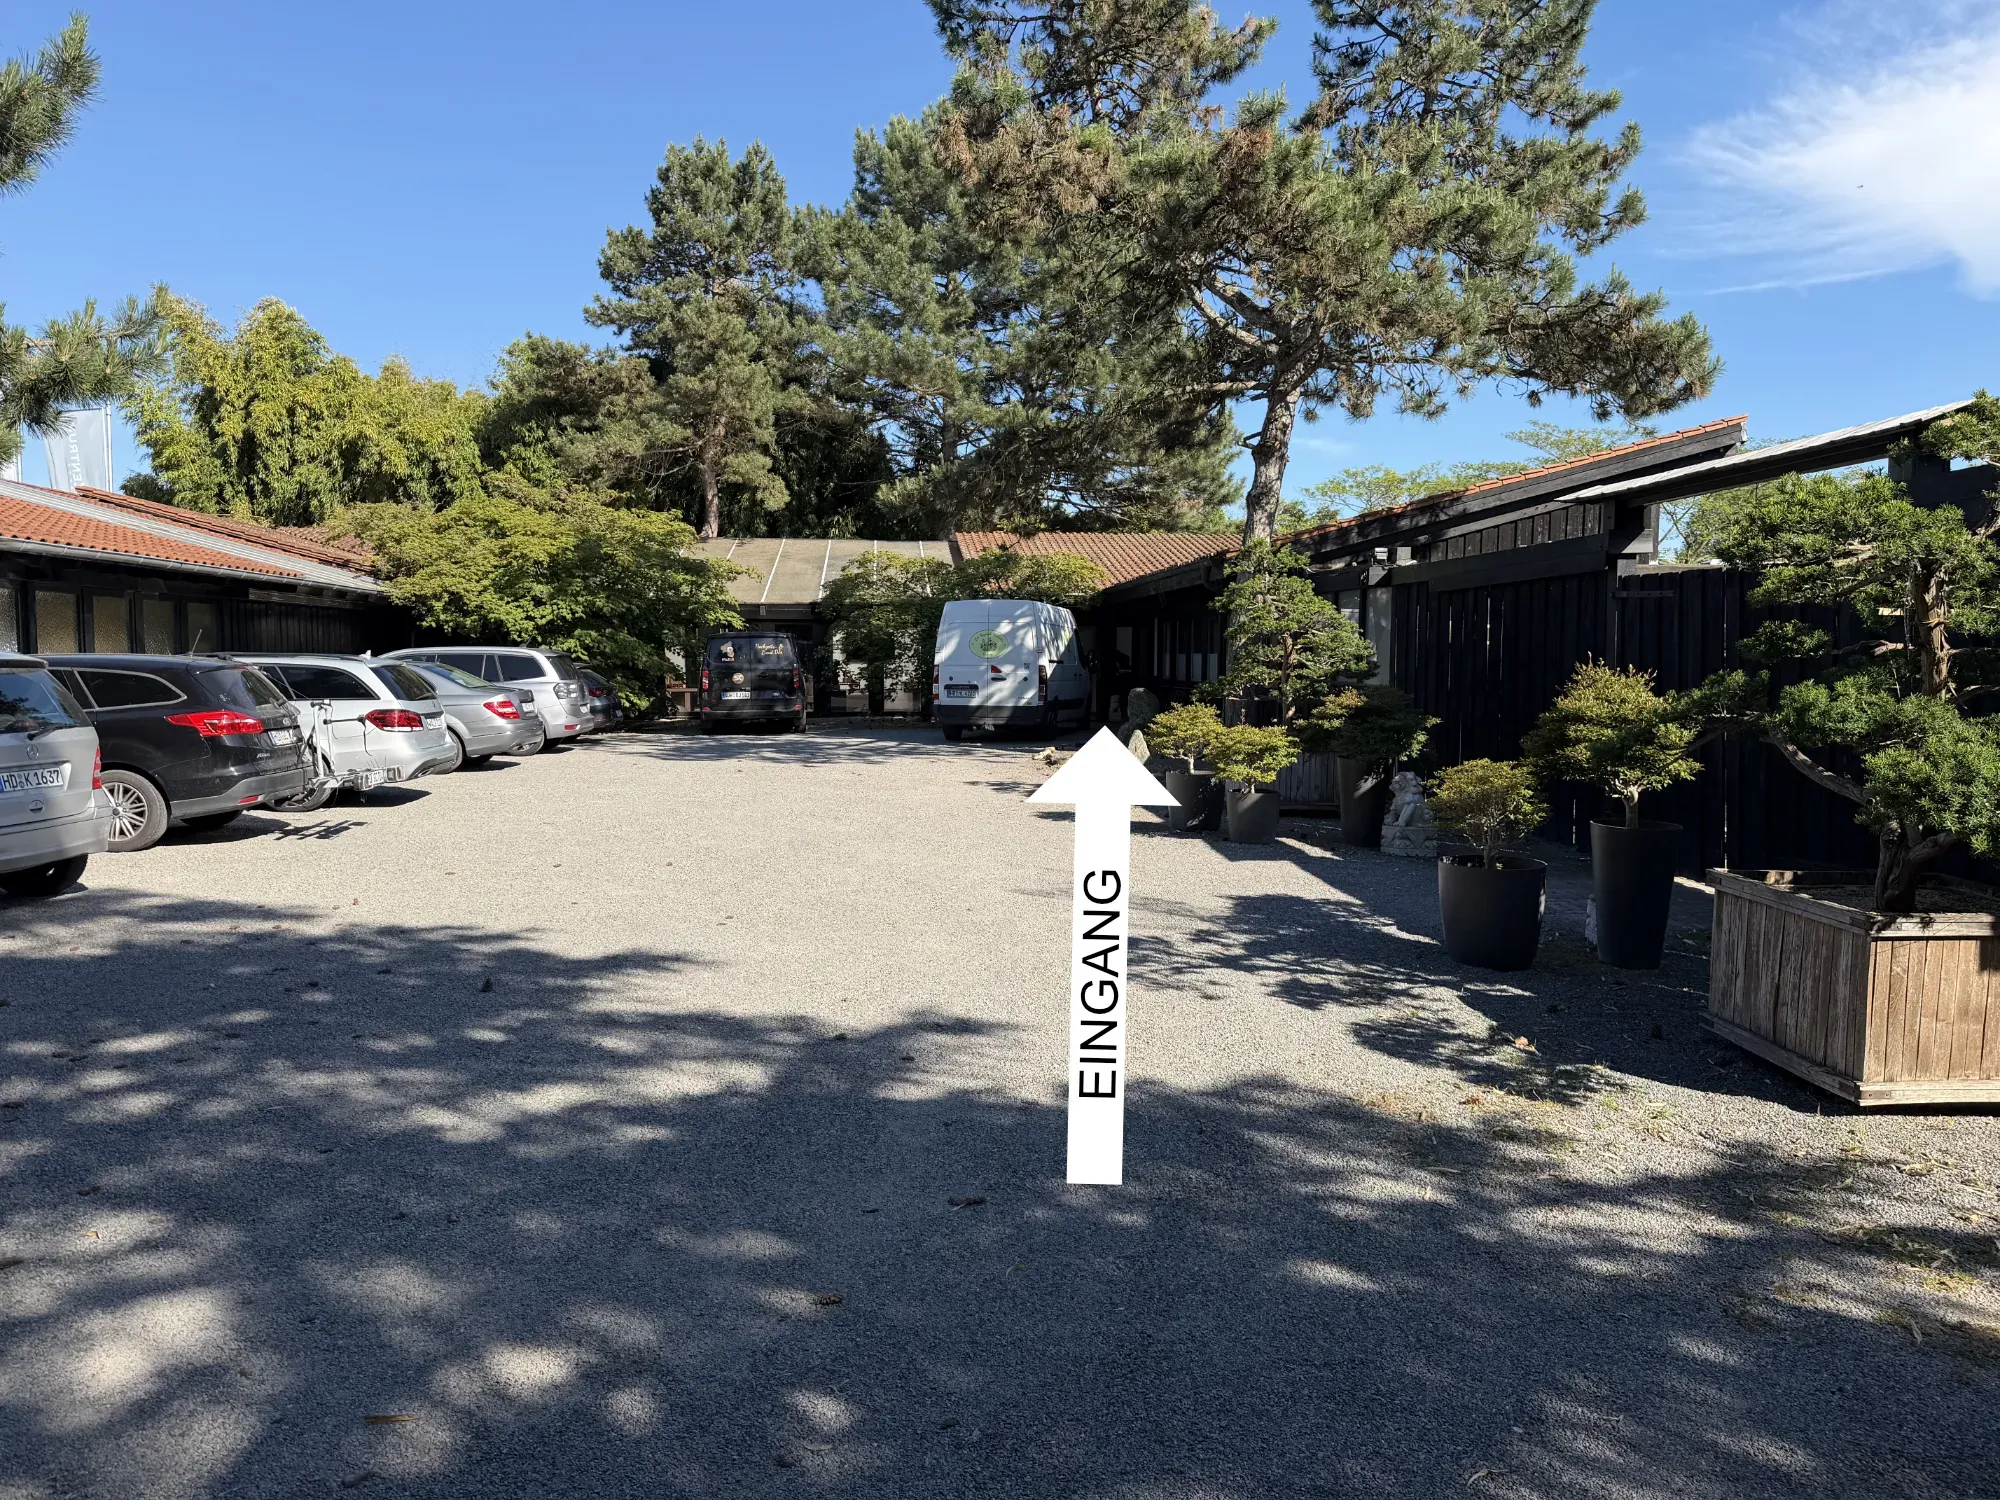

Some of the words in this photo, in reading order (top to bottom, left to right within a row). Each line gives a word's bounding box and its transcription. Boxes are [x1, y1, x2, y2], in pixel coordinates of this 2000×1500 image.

[2, 774, 18, 789] HD
[23, 772, 34, 787] K
[33, 769, 60, 786] 1637
